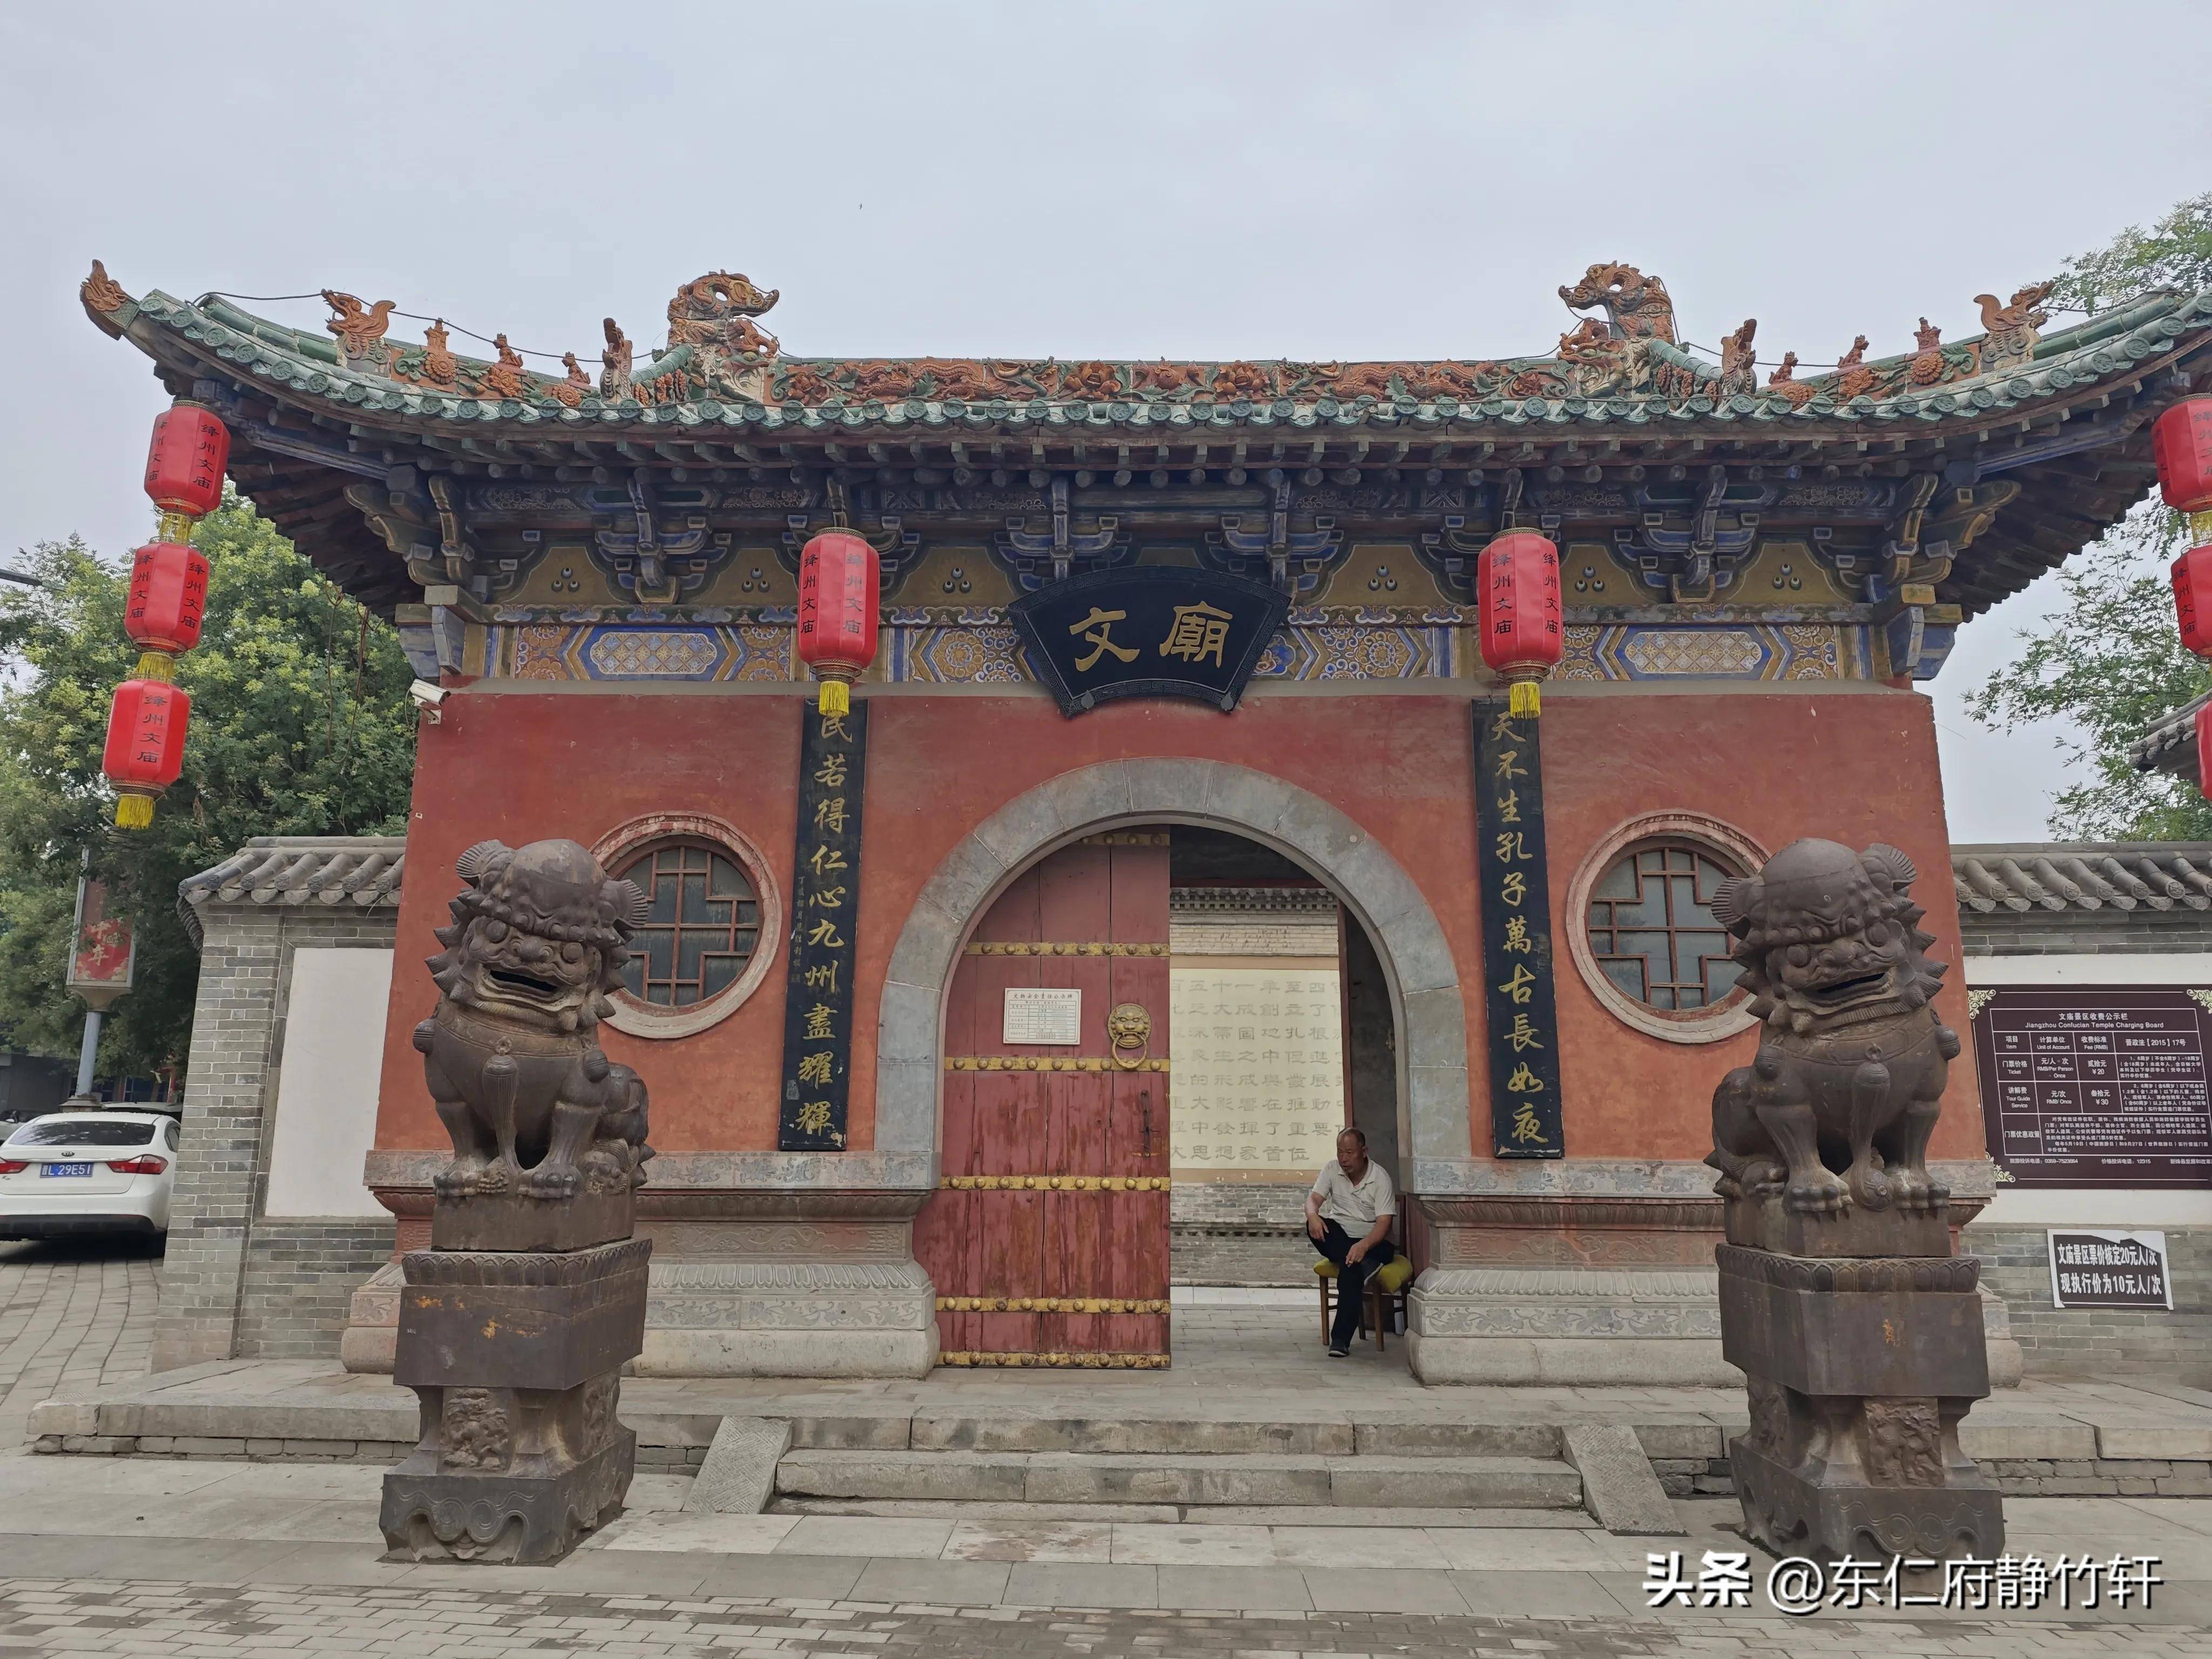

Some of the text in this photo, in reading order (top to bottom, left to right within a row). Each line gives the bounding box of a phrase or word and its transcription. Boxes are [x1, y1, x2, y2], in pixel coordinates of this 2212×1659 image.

[192, 424, 219, 489] 绛州文庙
[129, 554, 153, 618] 绛州文庙
[181, 562, 205, 629] 绛州文庙
[800, 553, 818, 634] 绛州文庙
[842, 554, 864, 634] 绛州文庙
[1492, 552, 1513, 634] 绛州文庙
[1543, 552, 1559, 635] 绛州文庙
[2174, 568, 2196, 636] 绛州文庙
[1069, 600, 1233, 672] 文廟
[136, 694, 168, 763] 绛州文庙
[2059, 1013, 2129, 1021] 文庙景区收费公示栏
